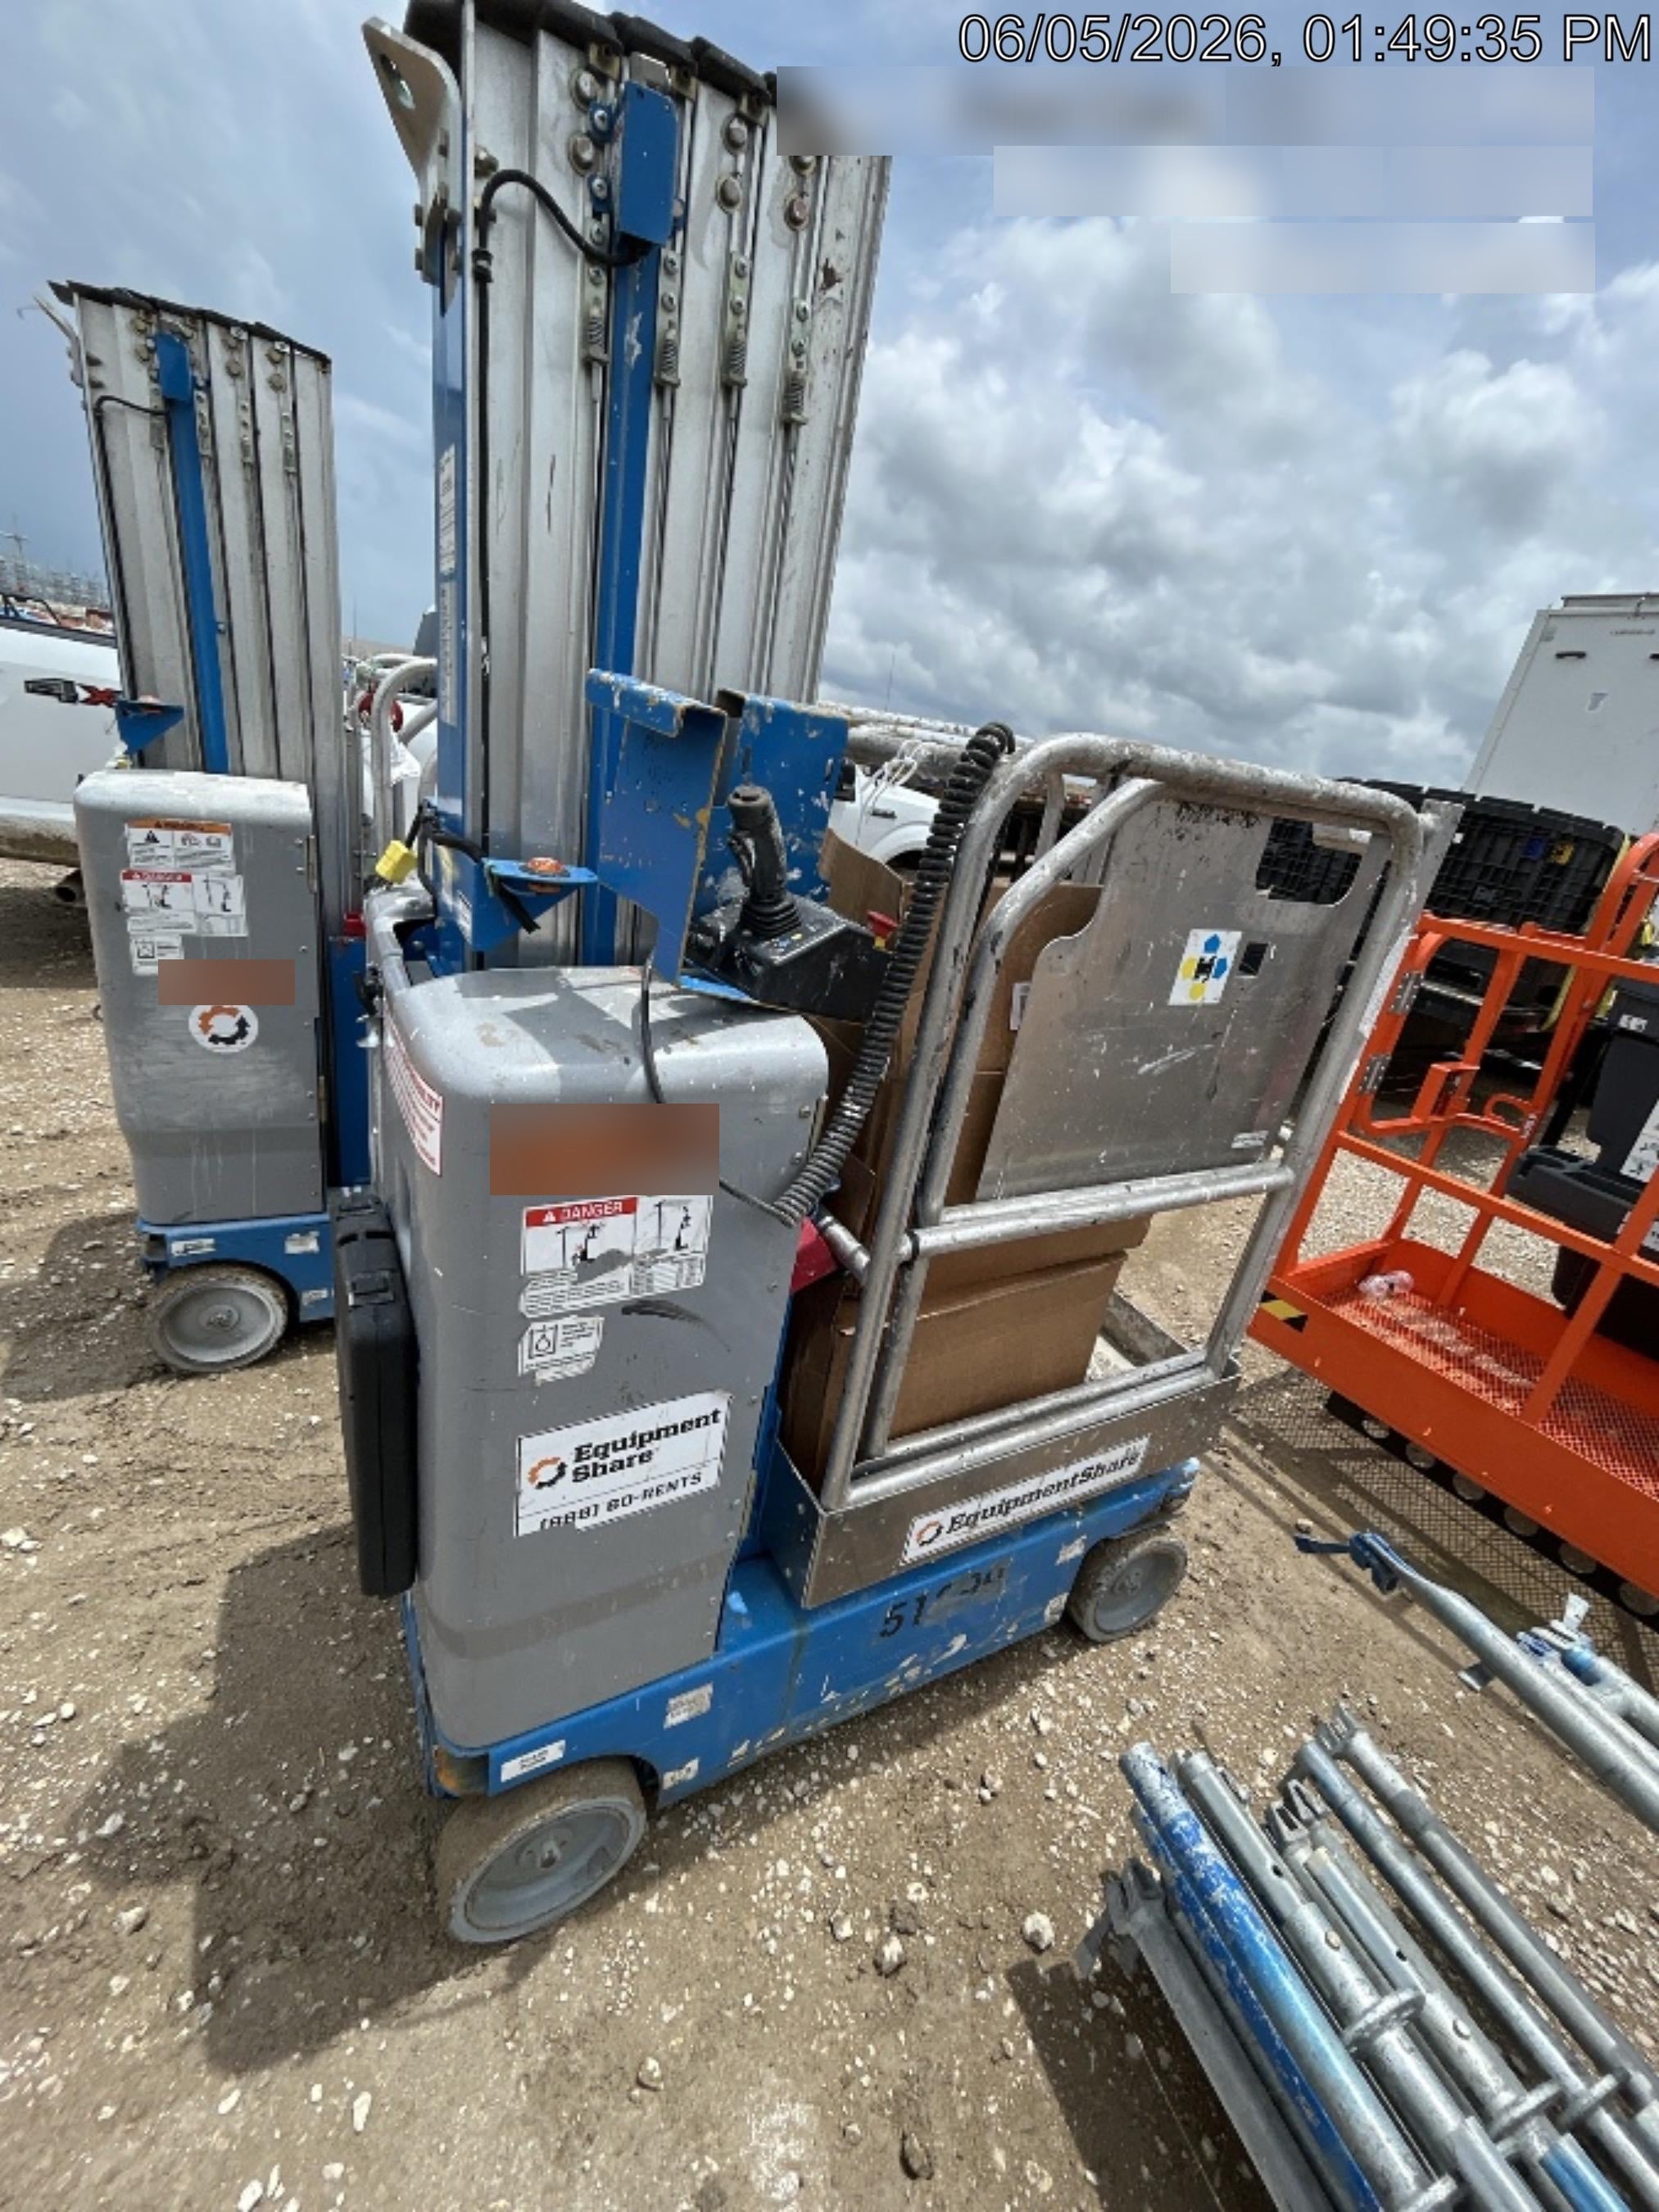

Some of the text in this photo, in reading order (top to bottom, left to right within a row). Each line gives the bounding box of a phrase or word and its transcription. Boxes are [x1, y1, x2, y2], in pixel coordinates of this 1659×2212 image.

[561, 1201, 623, 1220] DANGER
[574, 1408, 721, 1463] Equipment
[573, 1449, 655, 1483] Share
[945, 1450, 1141, 1534] EquipmentShare
